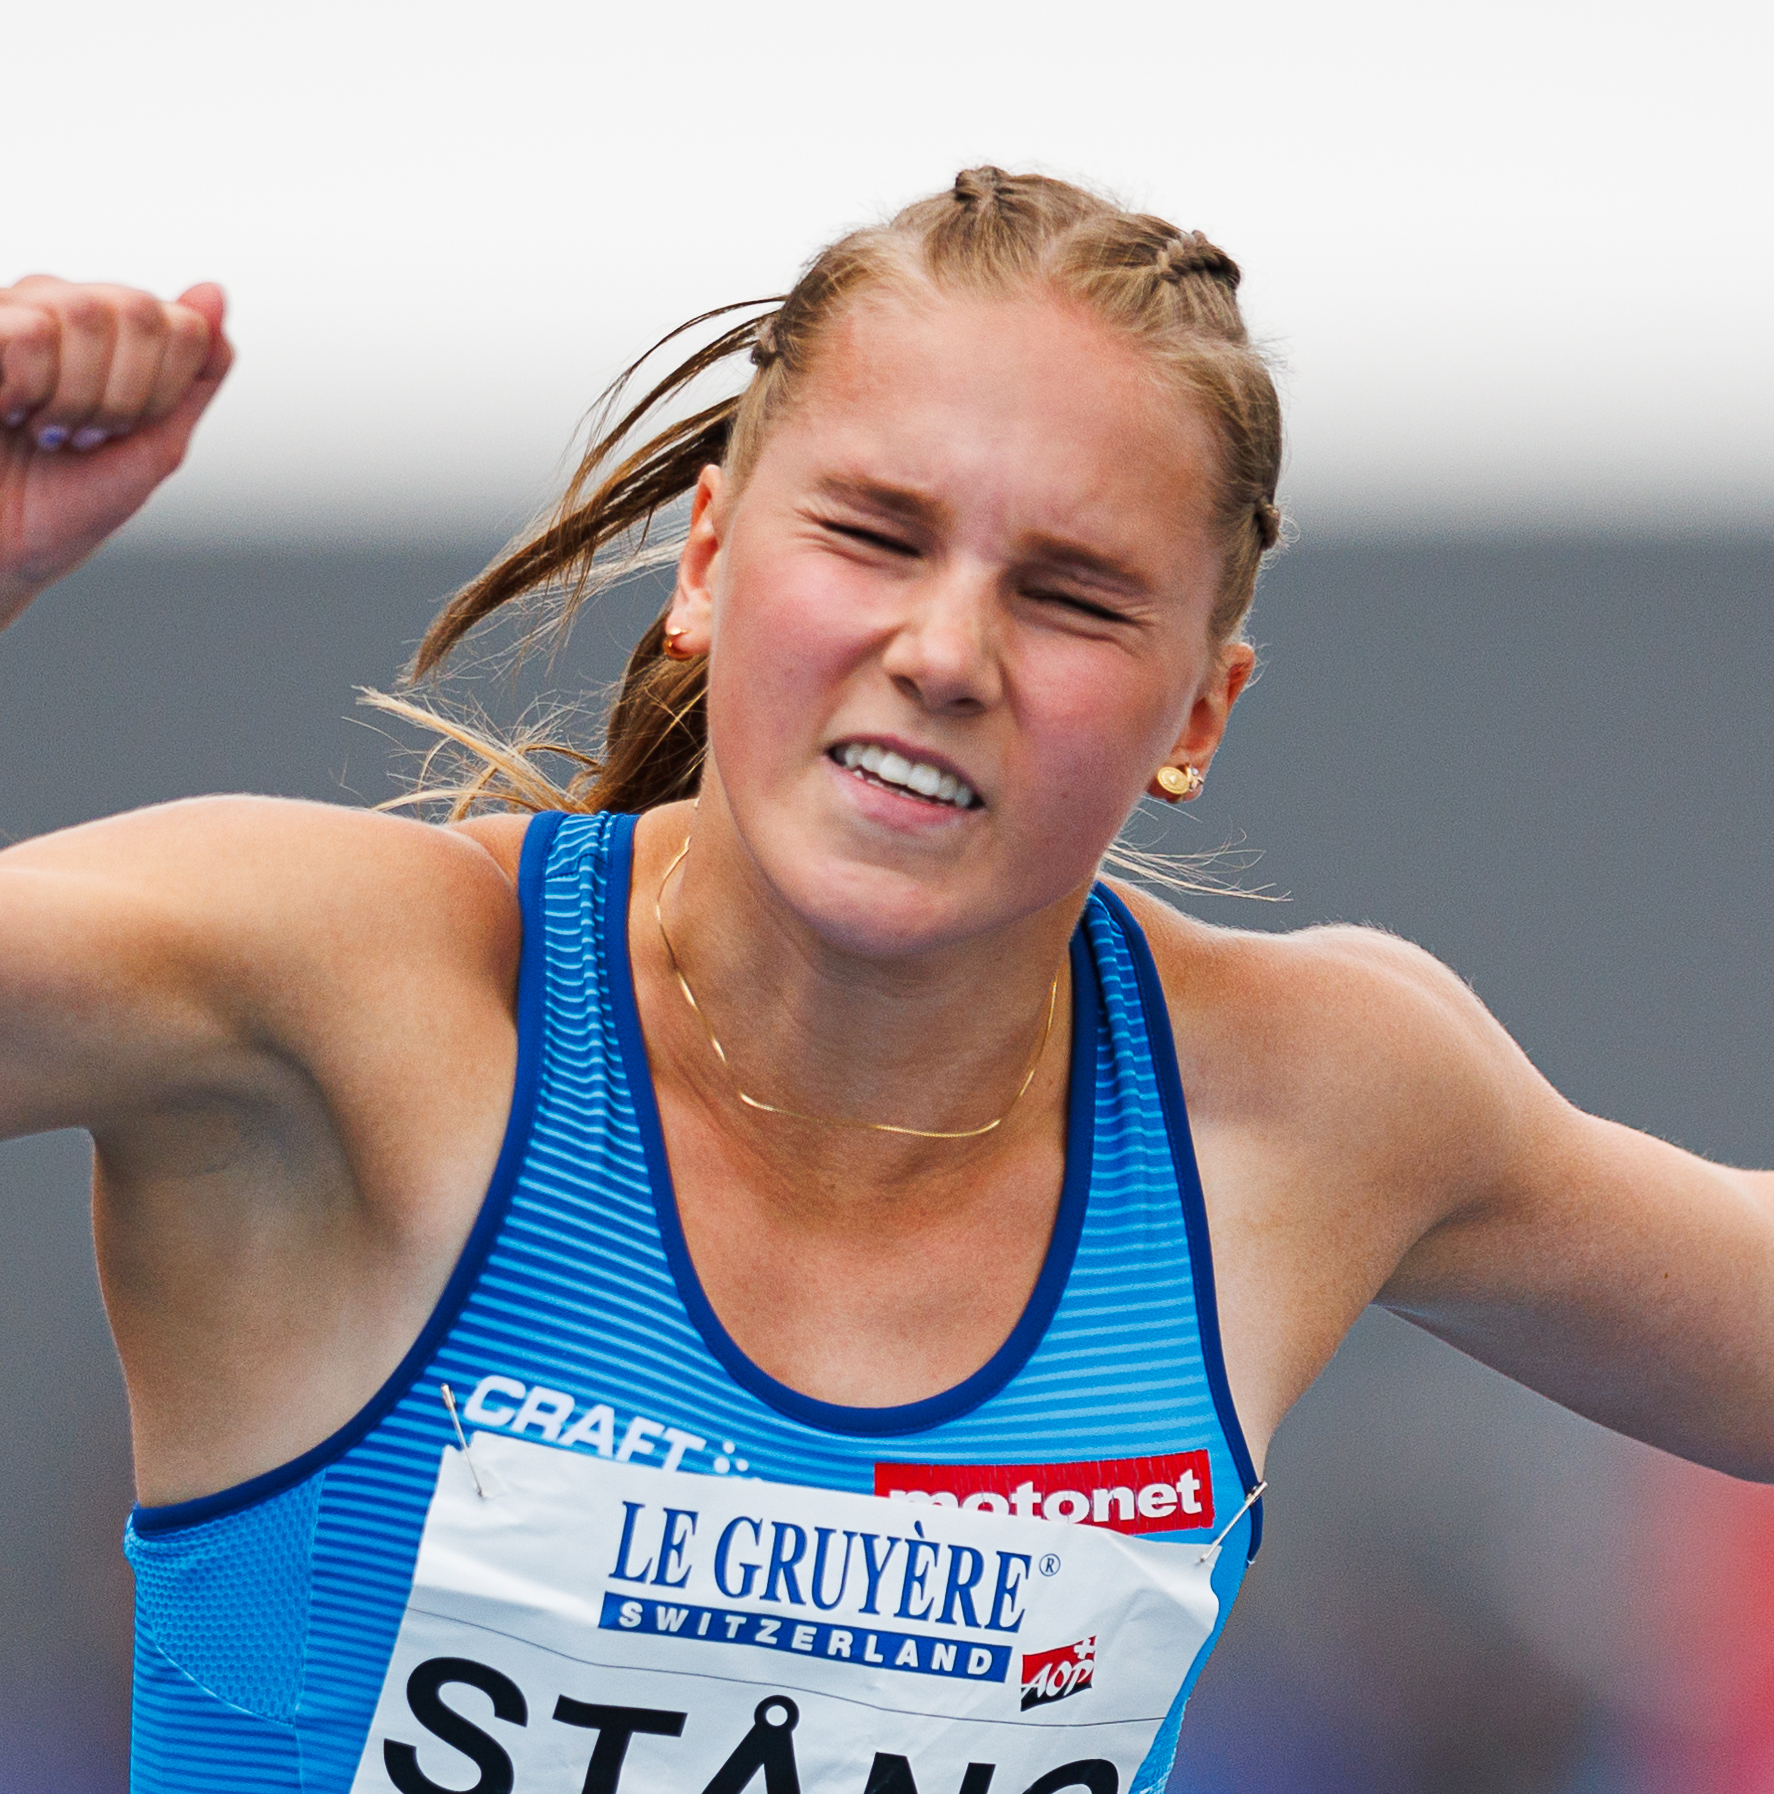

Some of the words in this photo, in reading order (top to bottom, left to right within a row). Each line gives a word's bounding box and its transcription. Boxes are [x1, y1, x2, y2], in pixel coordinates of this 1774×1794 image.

[464, 1375, 707, 1472] CRAFT
[609, 1501, 699, 1588] LE
[619, 1602, 993, 1676] SWITZERLAND
[1022, 1660, 1096, 1699] AOP
